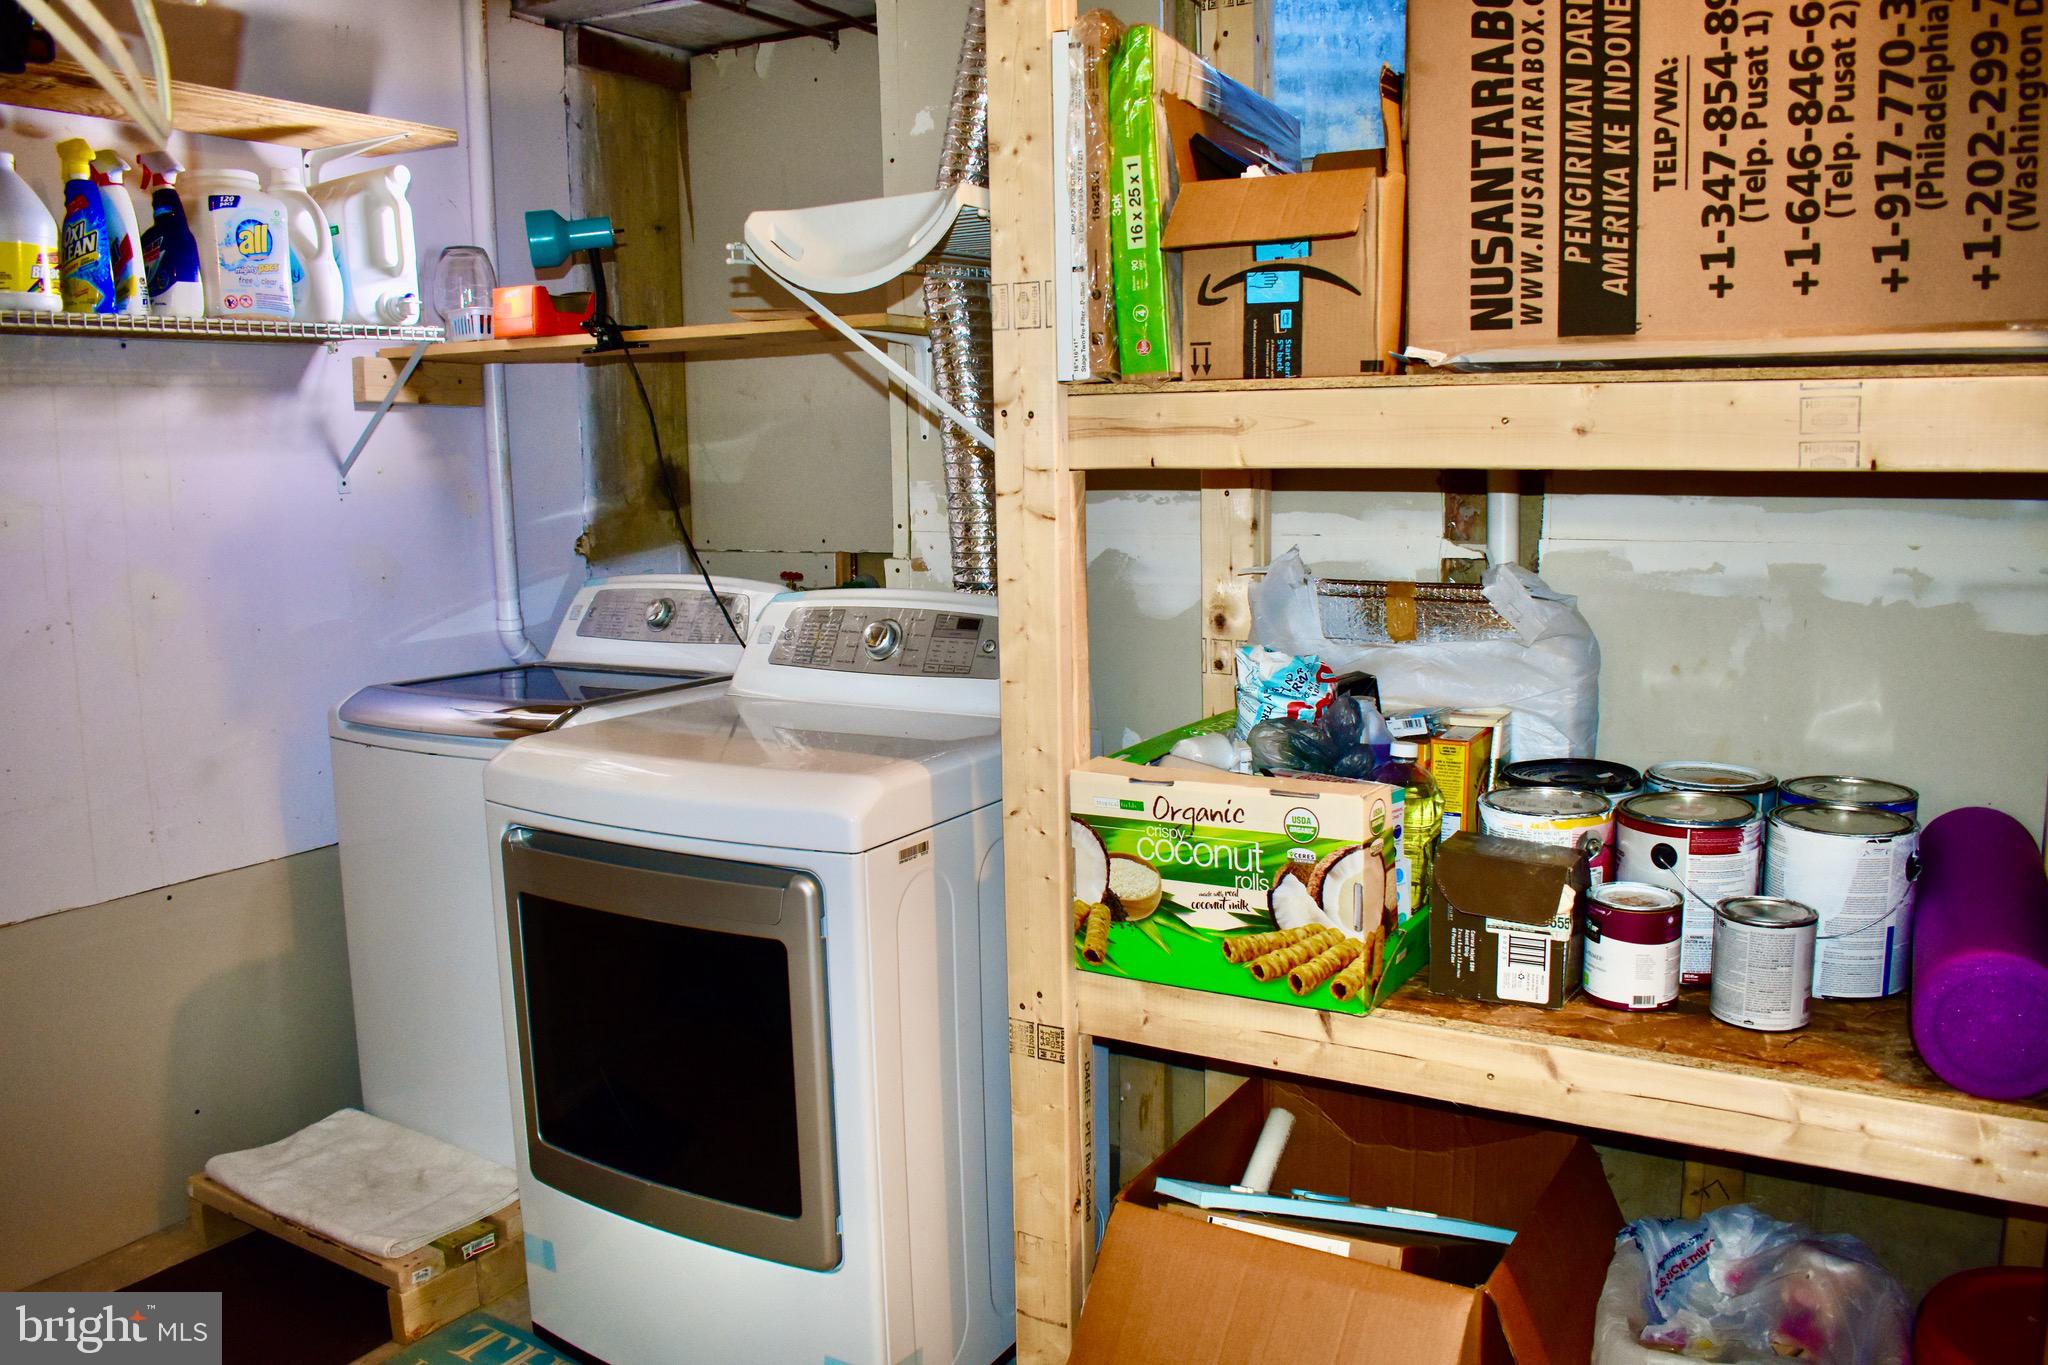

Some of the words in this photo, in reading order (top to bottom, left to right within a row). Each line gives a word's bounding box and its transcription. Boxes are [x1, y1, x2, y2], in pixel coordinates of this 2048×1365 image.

[1742, 10, 1774, 38] 1)
[1829, 0, 1861, 30] 2)
[1741, 44, 1769, 131] Pusat
[1827, 36, 1857, 125] Pusat
[1602, 122, 1631, 156] KE
[1653, 55, 1681, 193] TELP/WA:
[2005, 24, 2048, 232] (Washington
[1784, 0, 1826, 296] +1-646-846-6
[1872, 0, 1917, 293] +1-917-770-3
[1127, 161, 1139, 169] 1
[1130, 174, 1140, 184] x
[1470, 0, 1515, 331] NUSANTARAB
[1564, 77, 1593, 264] PENGIRIMAN
[1738, 136, 1774, 223] (Telp.
[1824, 131, 1861, 219] (Telp.
[1111, 192, 1122, 217] 3pk
[1129, 187, 1142, 207] 25
[1132, 214, 1143, 223] x
[1601, 165, 1630, 297] AMERIKA
[62, 230, 98, 264] EAN
[238, 223, 269, 254] all
[1131, 225, 1144, 243] 16
[238, 276, 253, 284] free
[261, 277, 277, 285] clear
[1131, 260, 1138, 271] 90
[1276, 352, 1284, 371] back
[1285, 339, 1293, 360] Start
[1152, 795, 1245, 839] Organic
[1291, 816, 1312, 825] USDA
[1146, 825, 1186, 842] crispy
[1137, 837, 1264, 873] coconut
[1223, 888, 1239, 898] real
[1235, 873, 1270, 891] rolls
[1191, 899, 1227, 910] coconut
[1228, 898, 1251, 911] milk
